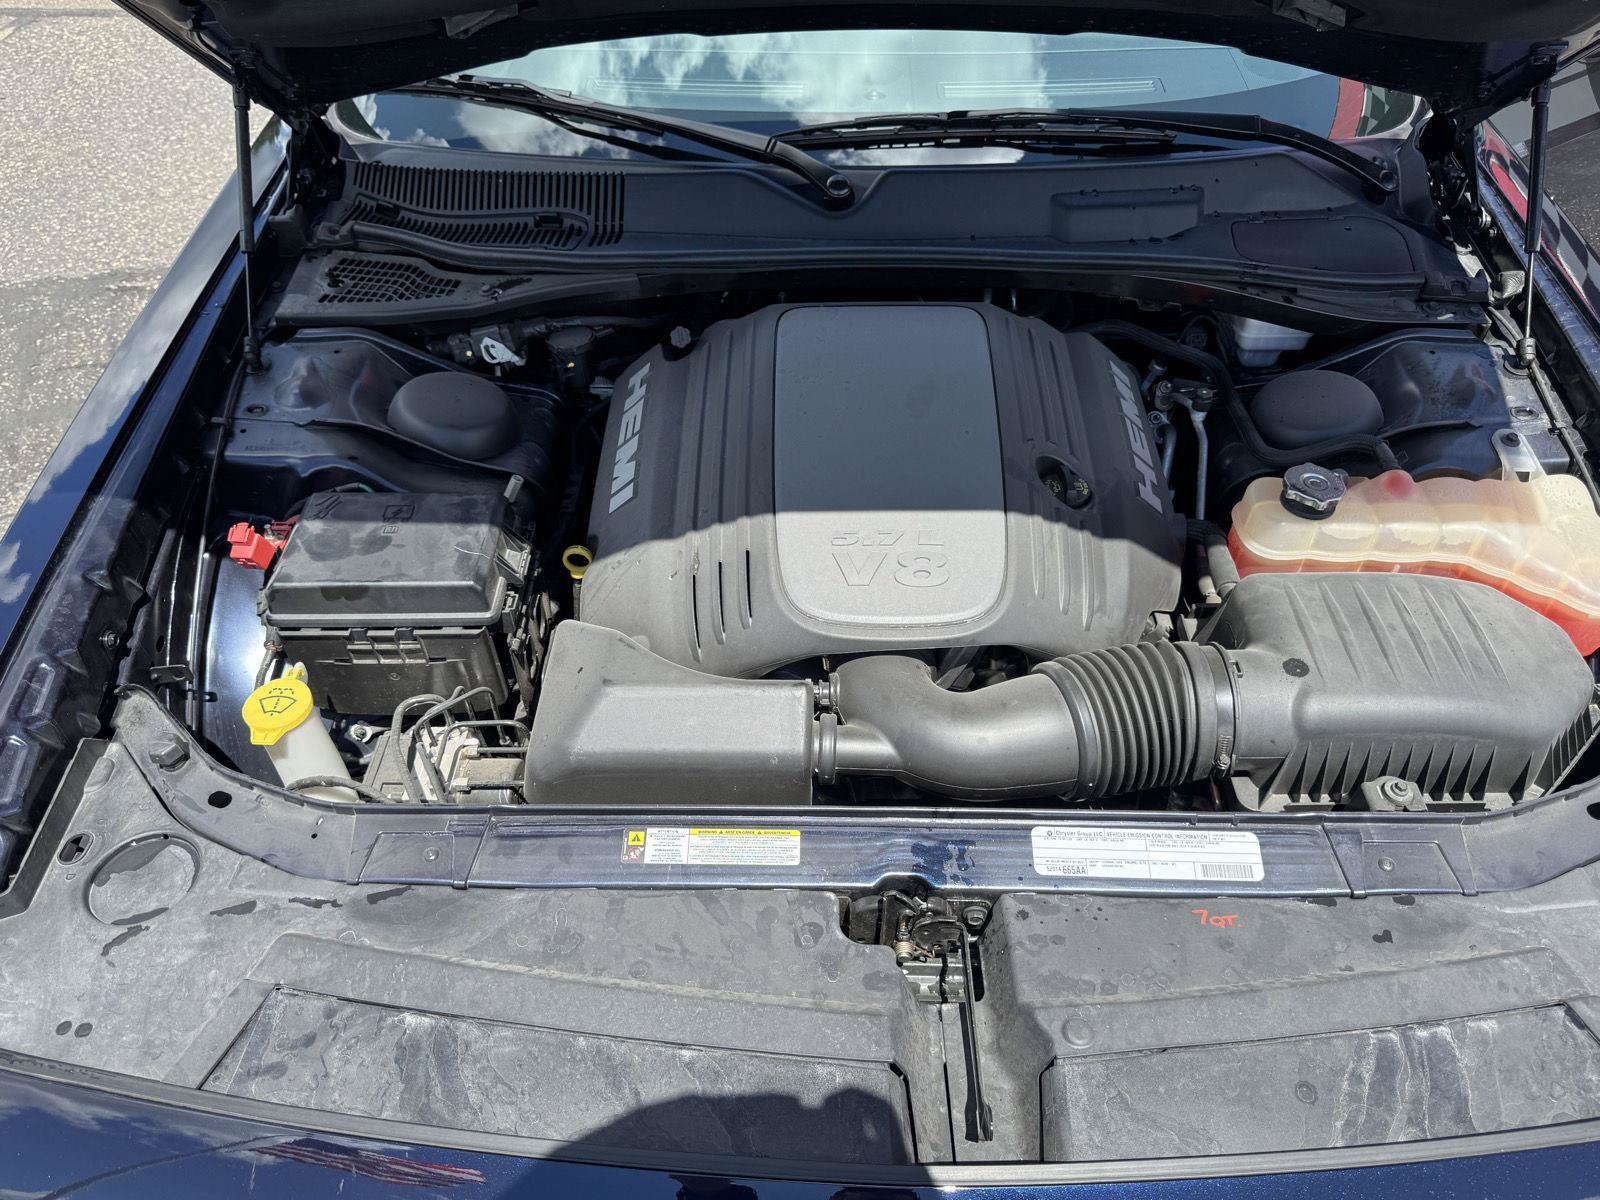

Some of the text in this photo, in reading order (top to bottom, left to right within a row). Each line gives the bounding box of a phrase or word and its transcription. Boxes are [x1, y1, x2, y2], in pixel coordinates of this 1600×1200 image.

[609, 362, 650, 514] HEMI
[1109, 360, 1163, 514] HEMI
[831, 550, 950, 588] V8
[1191, 908, 1208, 926] 7
